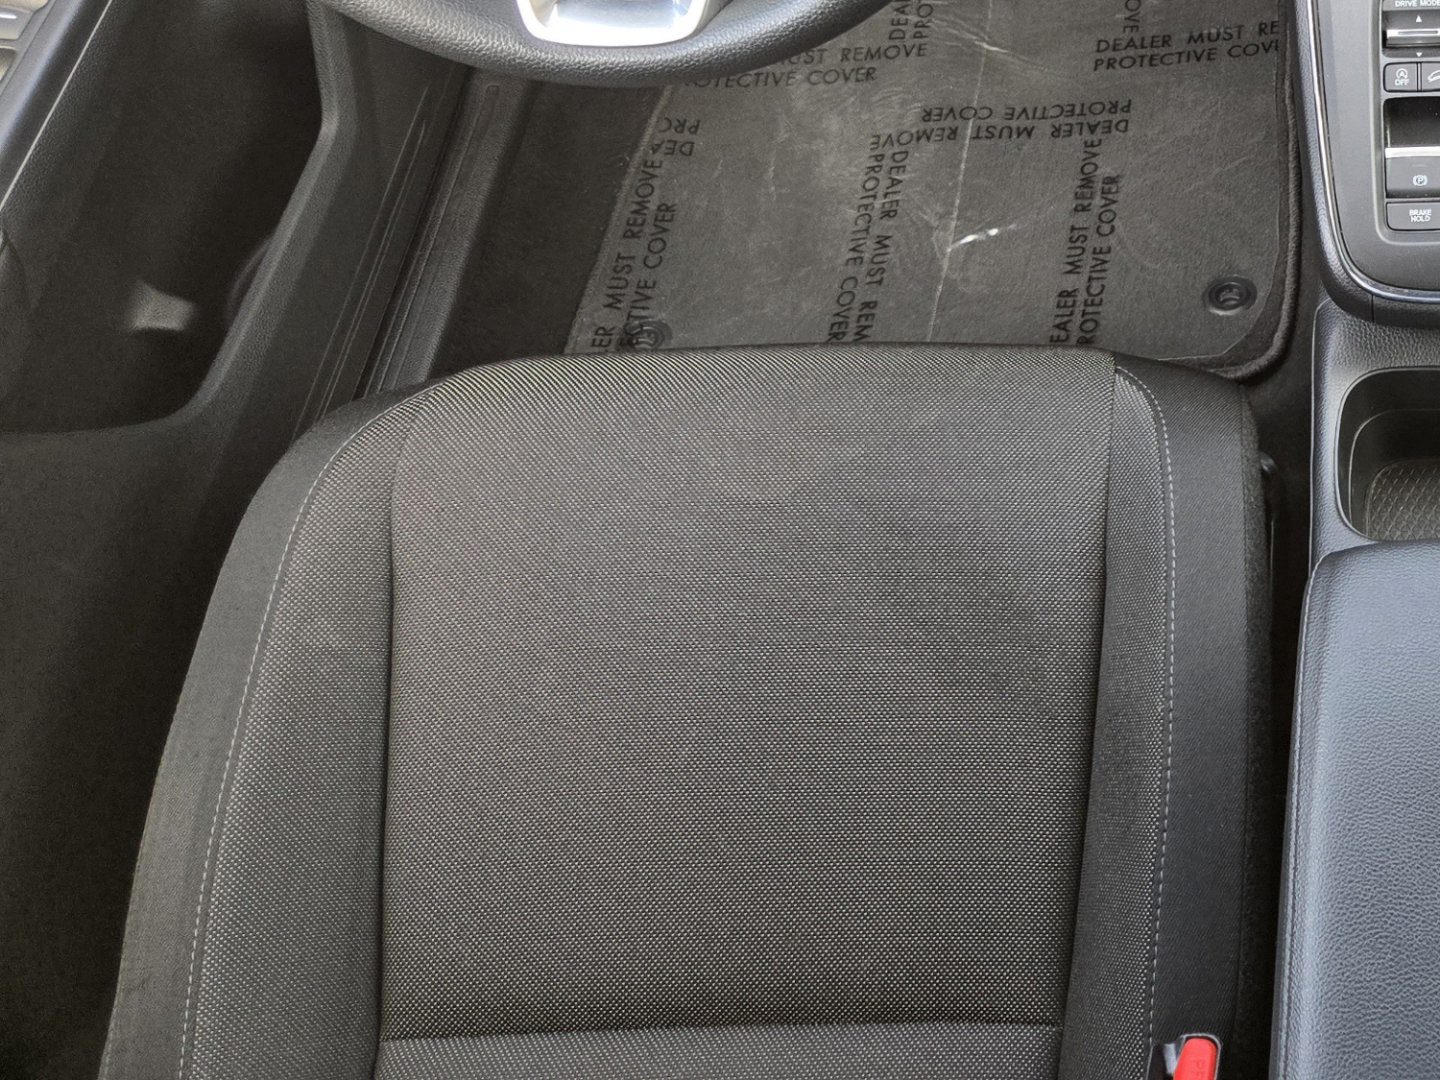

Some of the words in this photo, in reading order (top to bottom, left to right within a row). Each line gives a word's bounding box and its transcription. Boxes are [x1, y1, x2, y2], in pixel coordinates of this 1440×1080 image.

[1394, 0, 1418, 8] DRIVE
[839, 42, 929, 64] REMOVE
[1093, 47, 1218, 71] PROTECTIVE
[1227, 38, 1280, 60] COV
[1096, 33, 1172, 54] DEALER
[1186, 23, 1245, 46] MUST
[806, 65, 878, 87] COVER
[1394, 77, 1410, 86] OFF
[920, 105, 993, 123] COVER
[1004, 99, 1133, 121] PROTECTIVE
[869, 124, 959, 150] REMOVE
[970, 124, 1036, 141] MUST
[1049, 118, 1130, 140] DEALER
[879, 149, 910, 222] DEALER
[1072, 137, 1103, 214] REMOVE
[844, 152, 886, 268] PROTECTIVE
[1409, 209, 1433, 217] BRAKE
[1410, 215, 1431, 223] HOLD
[602, 251, 637, 312] MUST
[622, 159, 664, 240] REMOVE
[643, 201, 678, 270] COVER
[1062, 221, 1090, 276] MUST
[864, 233, 895, 288] MUST
[1075, 244, 1113, 347] ROTECTIVE
[1095, 173, 1122, 238] COVER
[826, 275, 859, 344] COVER
[851, 299, 879, 343] REM
[1048, 286, 1079, 345] EALER
